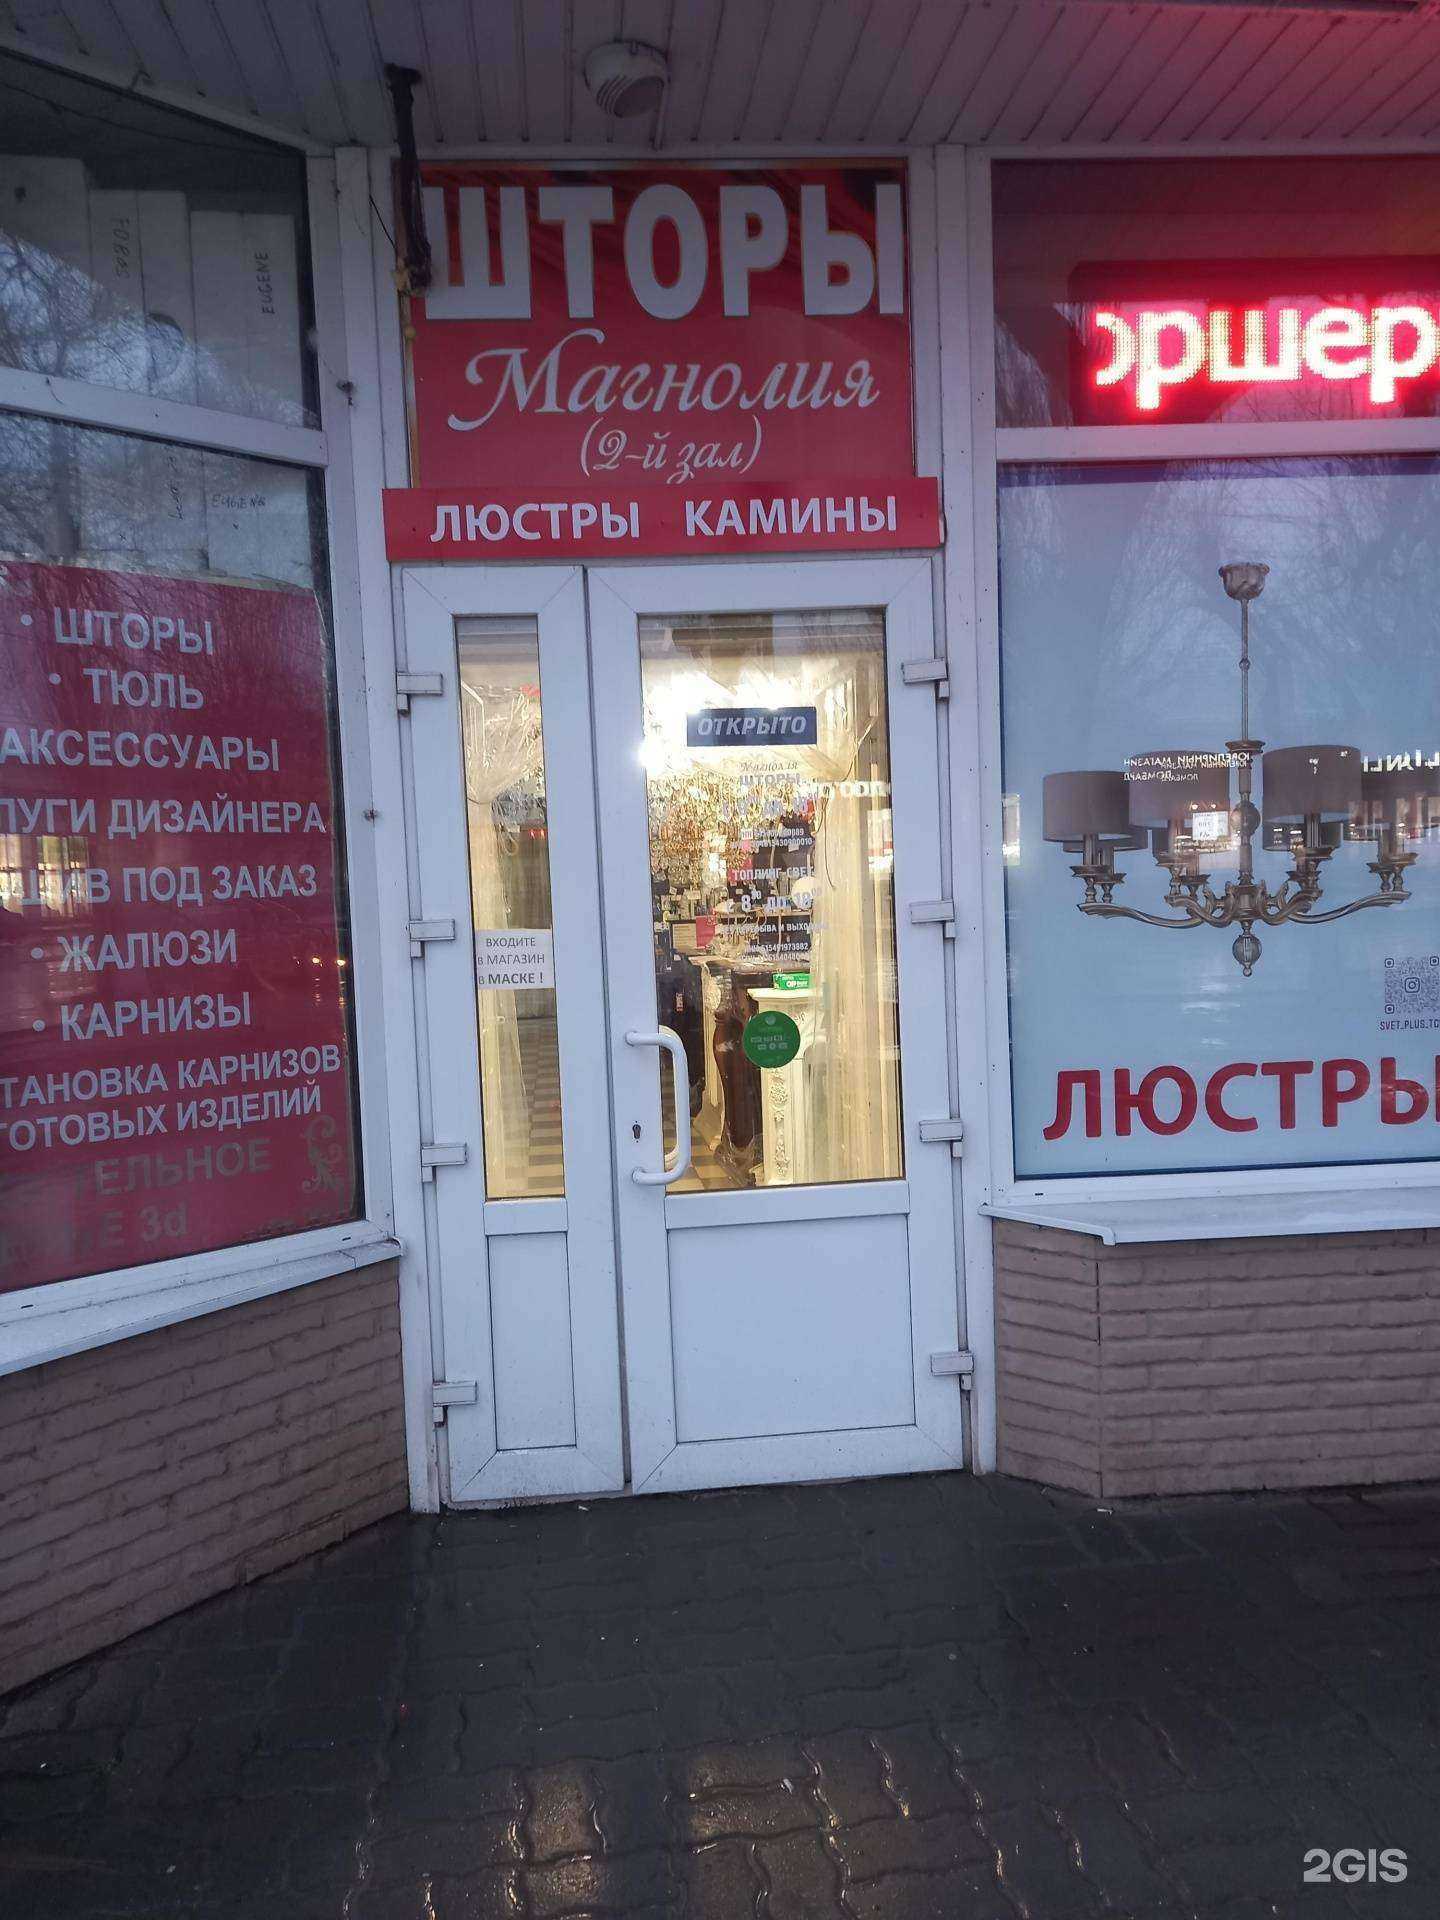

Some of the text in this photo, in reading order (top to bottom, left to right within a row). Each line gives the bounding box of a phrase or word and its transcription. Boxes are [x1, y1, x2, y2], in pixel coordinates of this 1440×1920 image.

[425, 183, 904, 320] ШТОРЫ
[446, 328, 880, 431] Магнолия
[430, 496, 898, 542] ЛЮСТРЫ КАМИНЫ
[54, 607, 215, 655] ШТОРЫ
[83, 668, 205, 710] ТЮЛЬ
[696, 715, 807, 736] ОТКРЫТО
[0, 727, 280, 772] АКСЕССУАРЫ
[108, 792, 327, 840] ДИЗАЙНЕРА
[122, 866, 204, 908] ПОД
[212, 864, 317, 899] ЗАКАЗ
[57, 928, 237, 972] ЖАЛЮЗИ
[486, 937, 536, 948] ВХОДИТЕ
[487, 953, 545, 965] МАГАЗИН
[488, 973, 536, 985] МАСКЕ
[60, 992, 251, 1041] КАРНИЗЫ
[177, 1044, 342, 1090] КАРНИЗОВ
[0, 1079, 321, 1151] ОТОВЫХ ИЗДЕЛИЙ
